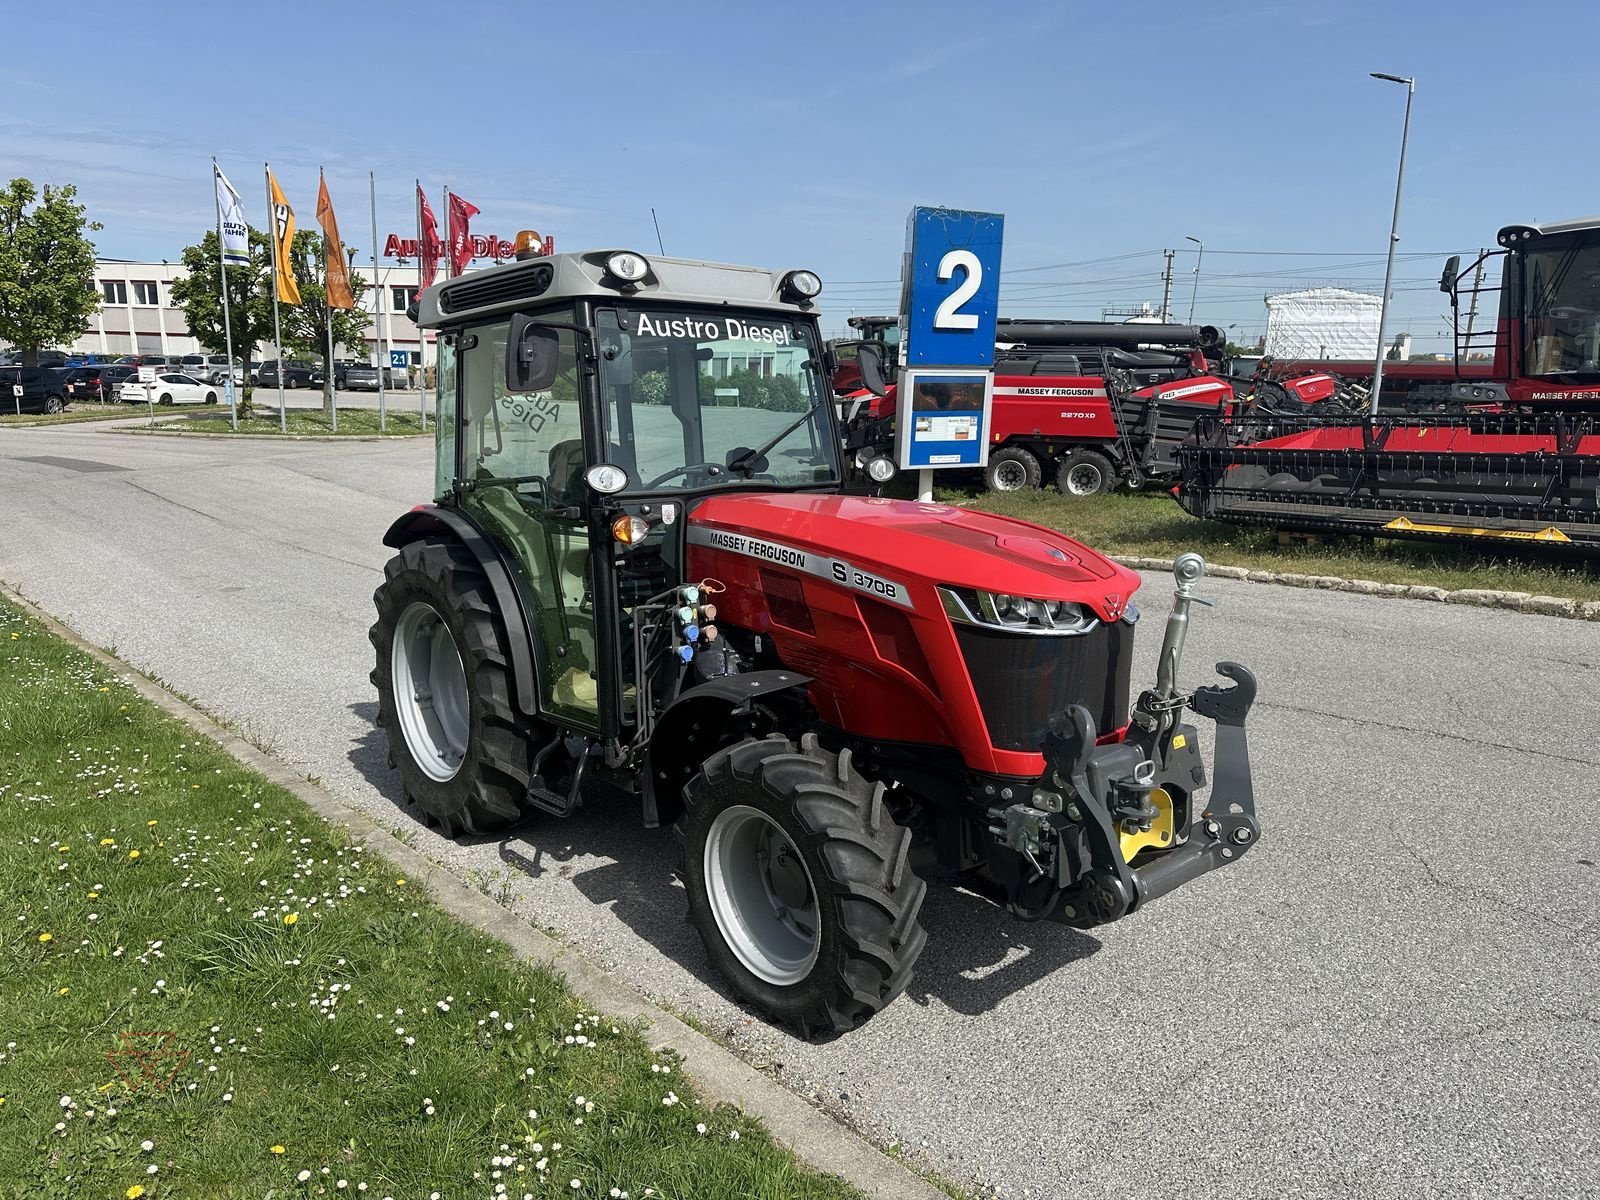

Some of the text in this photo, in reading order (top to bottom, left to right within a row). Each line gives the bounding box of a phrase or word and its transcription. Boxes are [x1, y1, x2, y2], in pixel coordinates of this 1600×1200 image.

[224, 222, 246, 232] DEUTZ
[225, 229, 245, 237] FAHR
[470, 234, 554, 258] Diel
[933, 249, 982, 329] 2
[637, 313, 790, 346] Austro Diesel
[392, 353, 405, 365] 2.1
[1052, 388, 1094, 396] FERGUSON
[1532, 392, 1569, 400] MASSEY
[710, 532, 896, 598] MASSEY FERGUSON S 3708
